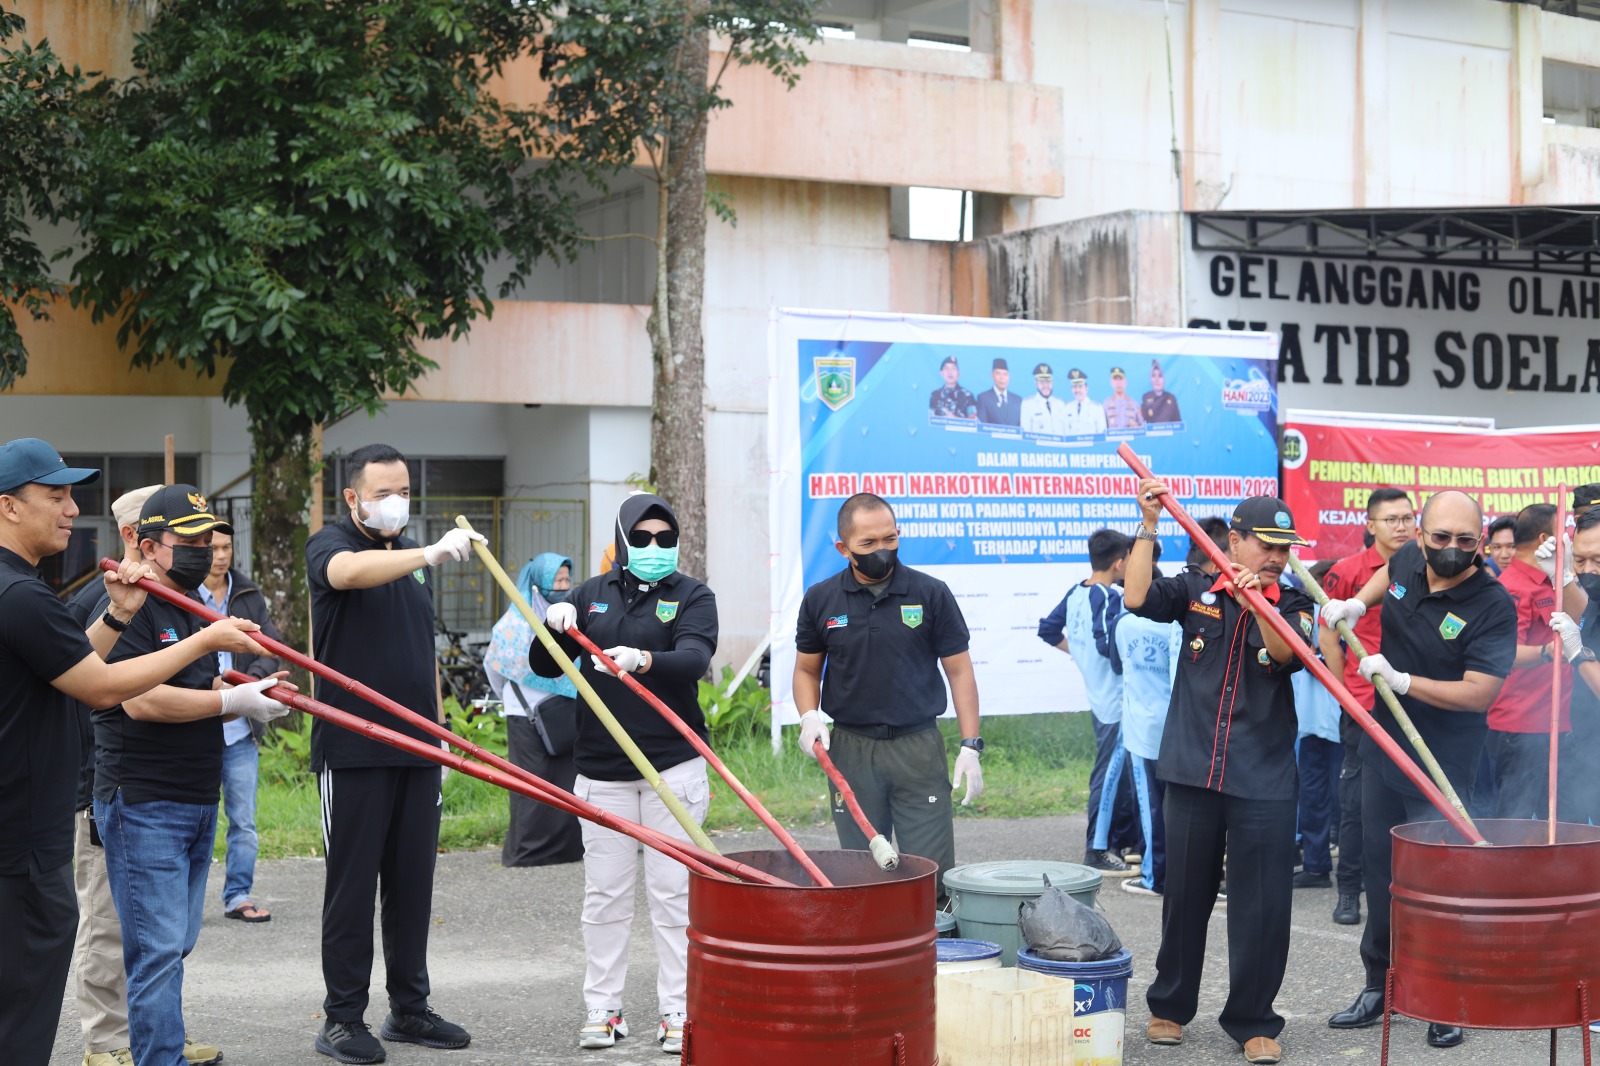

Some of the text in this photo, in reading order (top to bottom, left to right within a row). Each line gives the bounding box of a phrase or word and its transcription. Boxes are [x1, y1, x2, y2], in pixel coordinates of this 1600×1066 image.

[1209, 254, 1600, 319] GELANGGANG OLAH
[1187, 318, 1411, 387] ATIB
[977, 452, 1152, 469] DALAM RANGKA MEMPERITI
[1309, 460, 1416, 486] PEMUSNAHAN
[1418, 465, 1485, 488] BARANG
[1486, 467, 1540, 489] BUKTI
[811, 475, 857, 496] HARI
[861, 475, 905, 495] ANTI
[910, 475, 1012, 495] NARKOTIKA
[1016, 475, 1140, 495] INTERNASIONAL
[1195, 478, 1241, 497] TAHUN
[1245, 477, 1277, 498] 2023
[890, 503, 938, 519] RINTAH
[940, 503, 973, 519] KOTA
[976, 503, 1026, 518] PADANG
[1029, 503, 1080, 518] PANJANG
[1082, 503, 1137, 518] BERSAMA
[1318, 509, 1369, 526] KEJAK
[966, 521, 1056, 537] TERWUJUDNYA
[1061, 521, 1105, 536] PADANG
[1158, 521, 1187, 536] KOTA
[973, 540, 1090, 556] TERHADAP ANCAMA
[1144, 646, 1157, 663] 2
